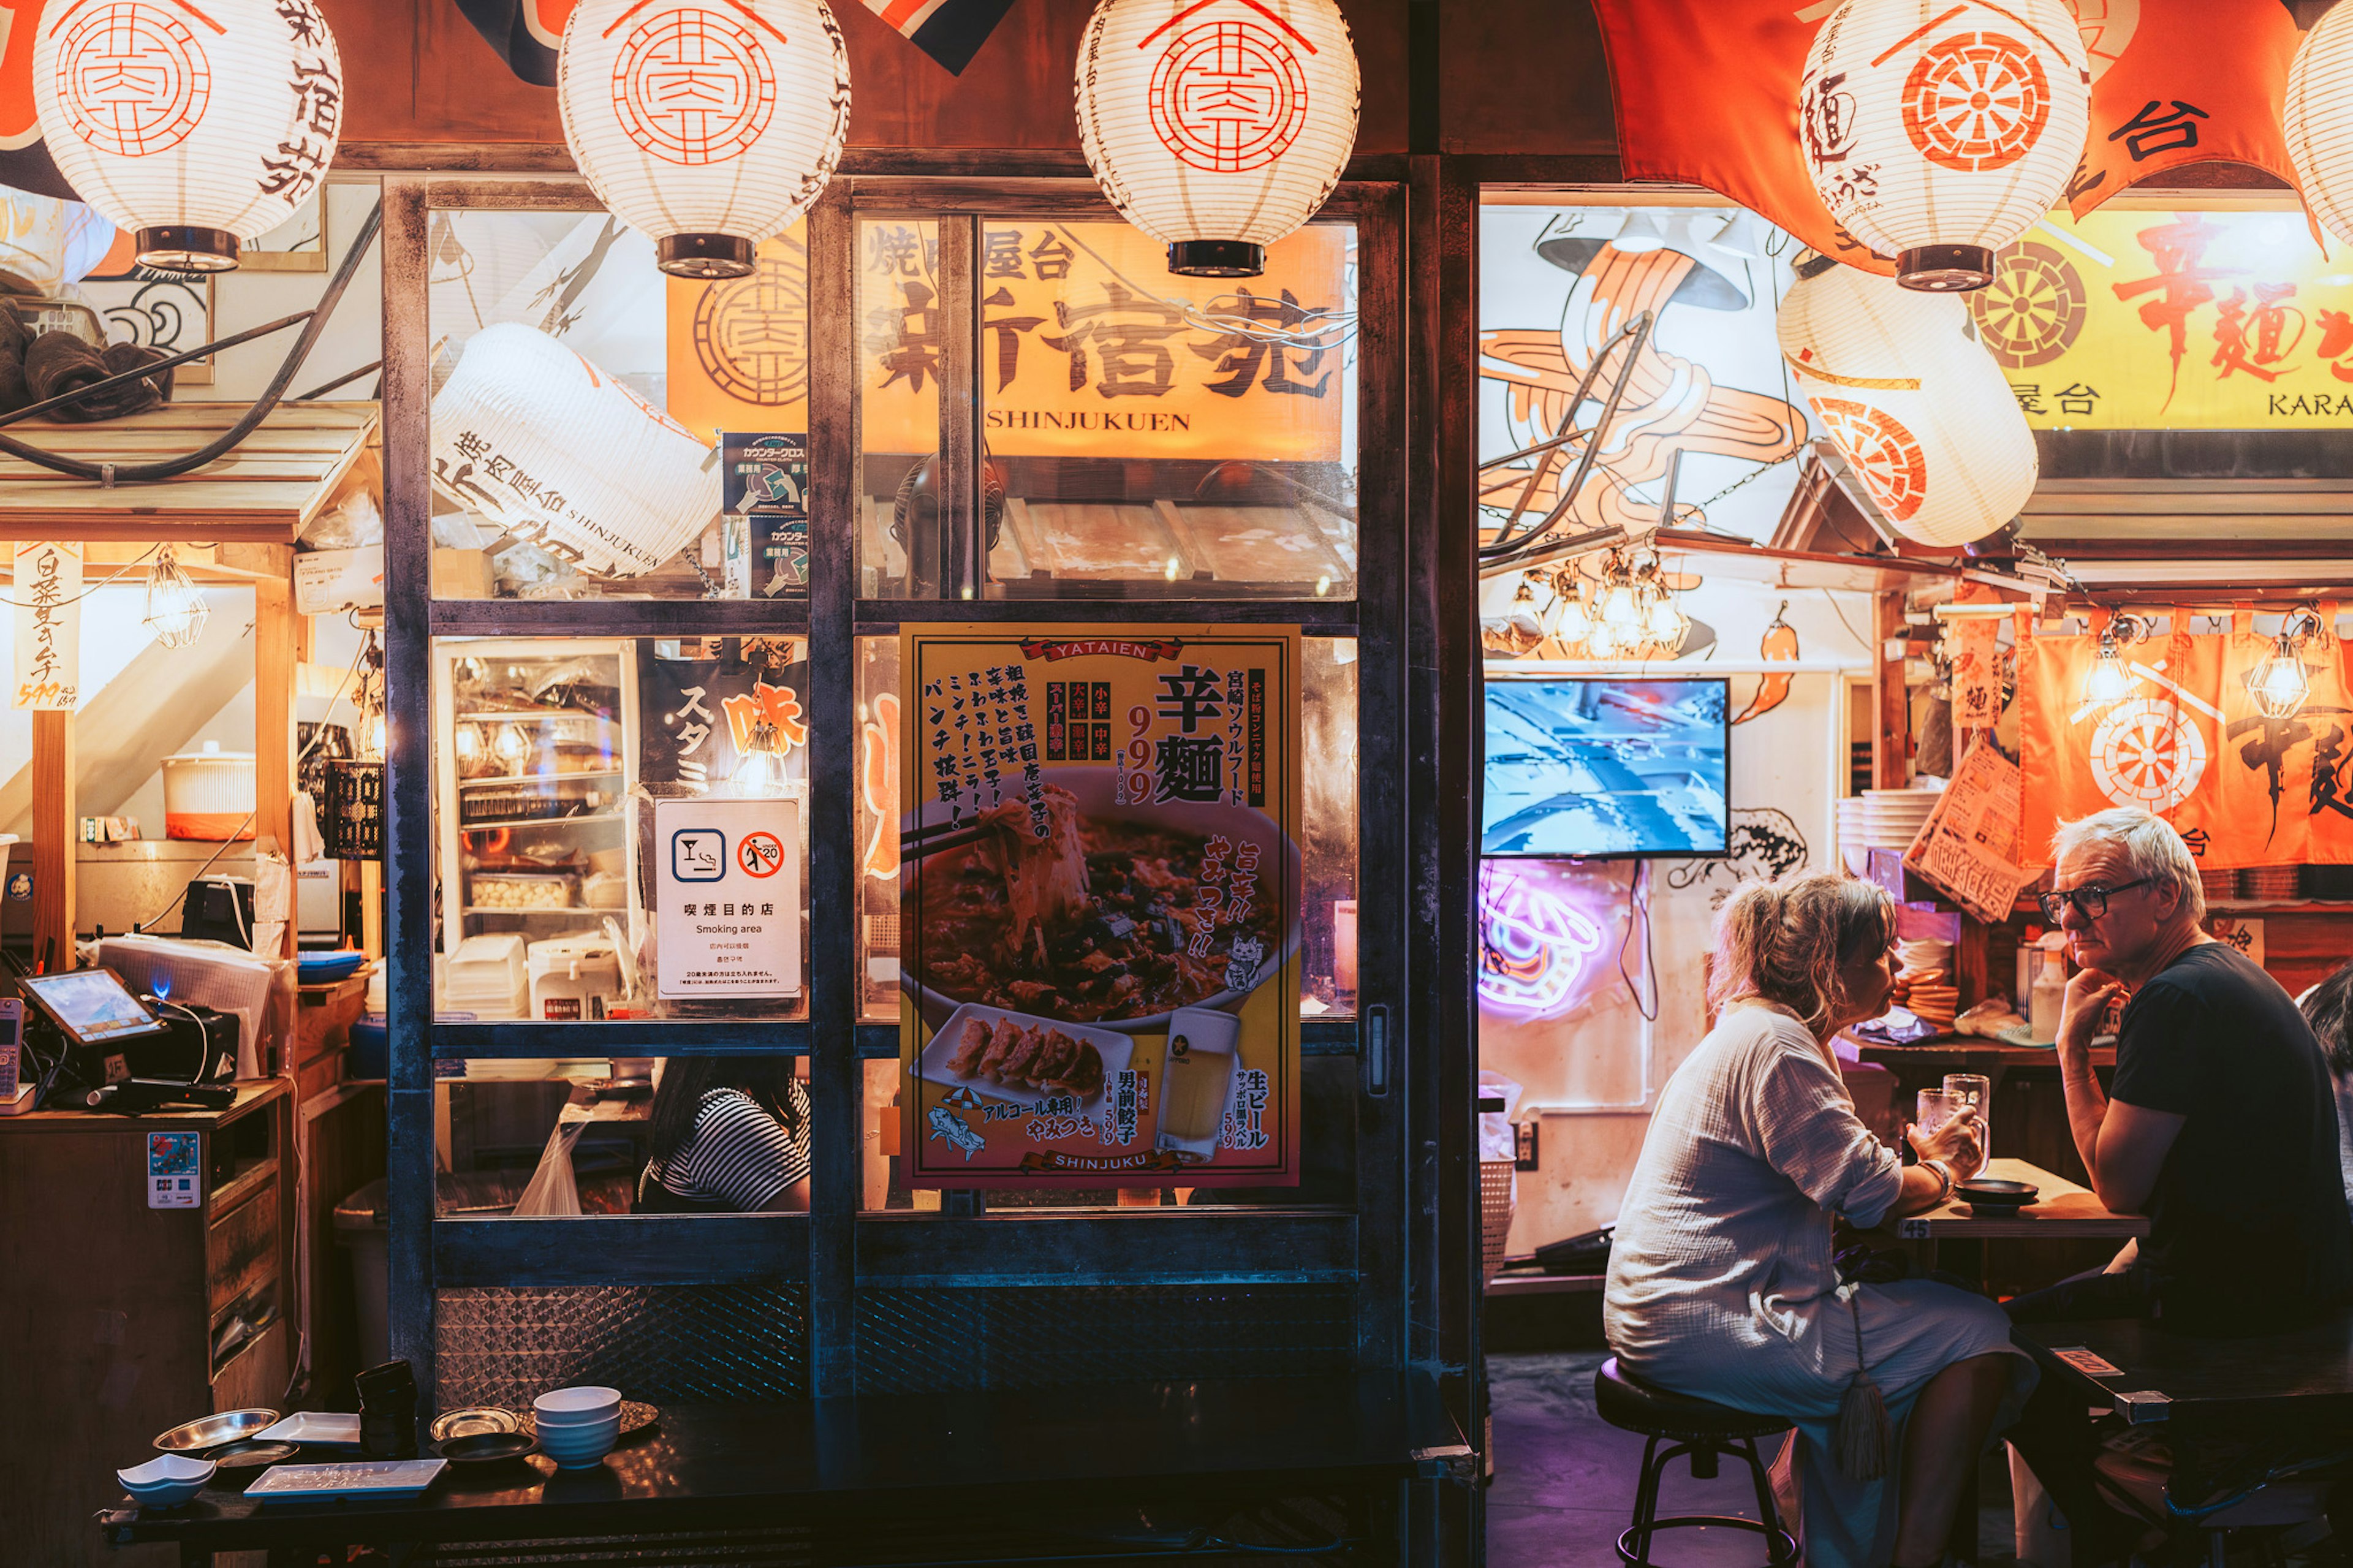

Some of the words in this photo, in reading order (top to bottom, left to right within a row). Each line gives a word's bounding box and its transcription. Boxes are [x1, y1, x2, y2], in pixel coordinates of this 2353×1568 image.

[863, 280, 1333, 400] 新宿苑
[987, 409, 1191, 433] SHINJUKUEN
[743, 447, 805, 458] カウンタークロス
[453, 430, 567, 512] 焼肉屋台
[566, 509, 661, 567] SHINJUKUEN
[1056, 642, 1146, 658] YATAIEN
[1071, 684, 1086, 711] 大辛
[1094, 687, 1108, 714] 小辛
[986, 667, 1018, 763] 辛味と旨味
[1048, 683, 1064, 752] スーパー激辛
[1006, 665, 1050, 838] 粗挽き韓国唐辛子の
[1072, 725, 1085, 753] 激辛
[1094, 727, 1108, 756] 中辛
[1227, 671, 1245, 806] 宮崎ソウルフード
[1129, 706, 1151, 805] 999
[763, 848, 777, 858] 20
[684, 903, 774, 916] 喫煙目的店
[697, 925, 738, 934] Smoking
[1118, 1071, 1135, 1145] 男前餃子
[1236, 1072, 1246, 1148] サッポロ黒ラベル
[1248, 1071, 1267, 1149] 生ビール
[1028, 1116, 1094, 1140] やみつき
[1224, 1112, 1233, 1147] 599
[1056, 1154, 1146, 1170] SHINJUKU
[1903, 1221, 1929, 1237] 45
